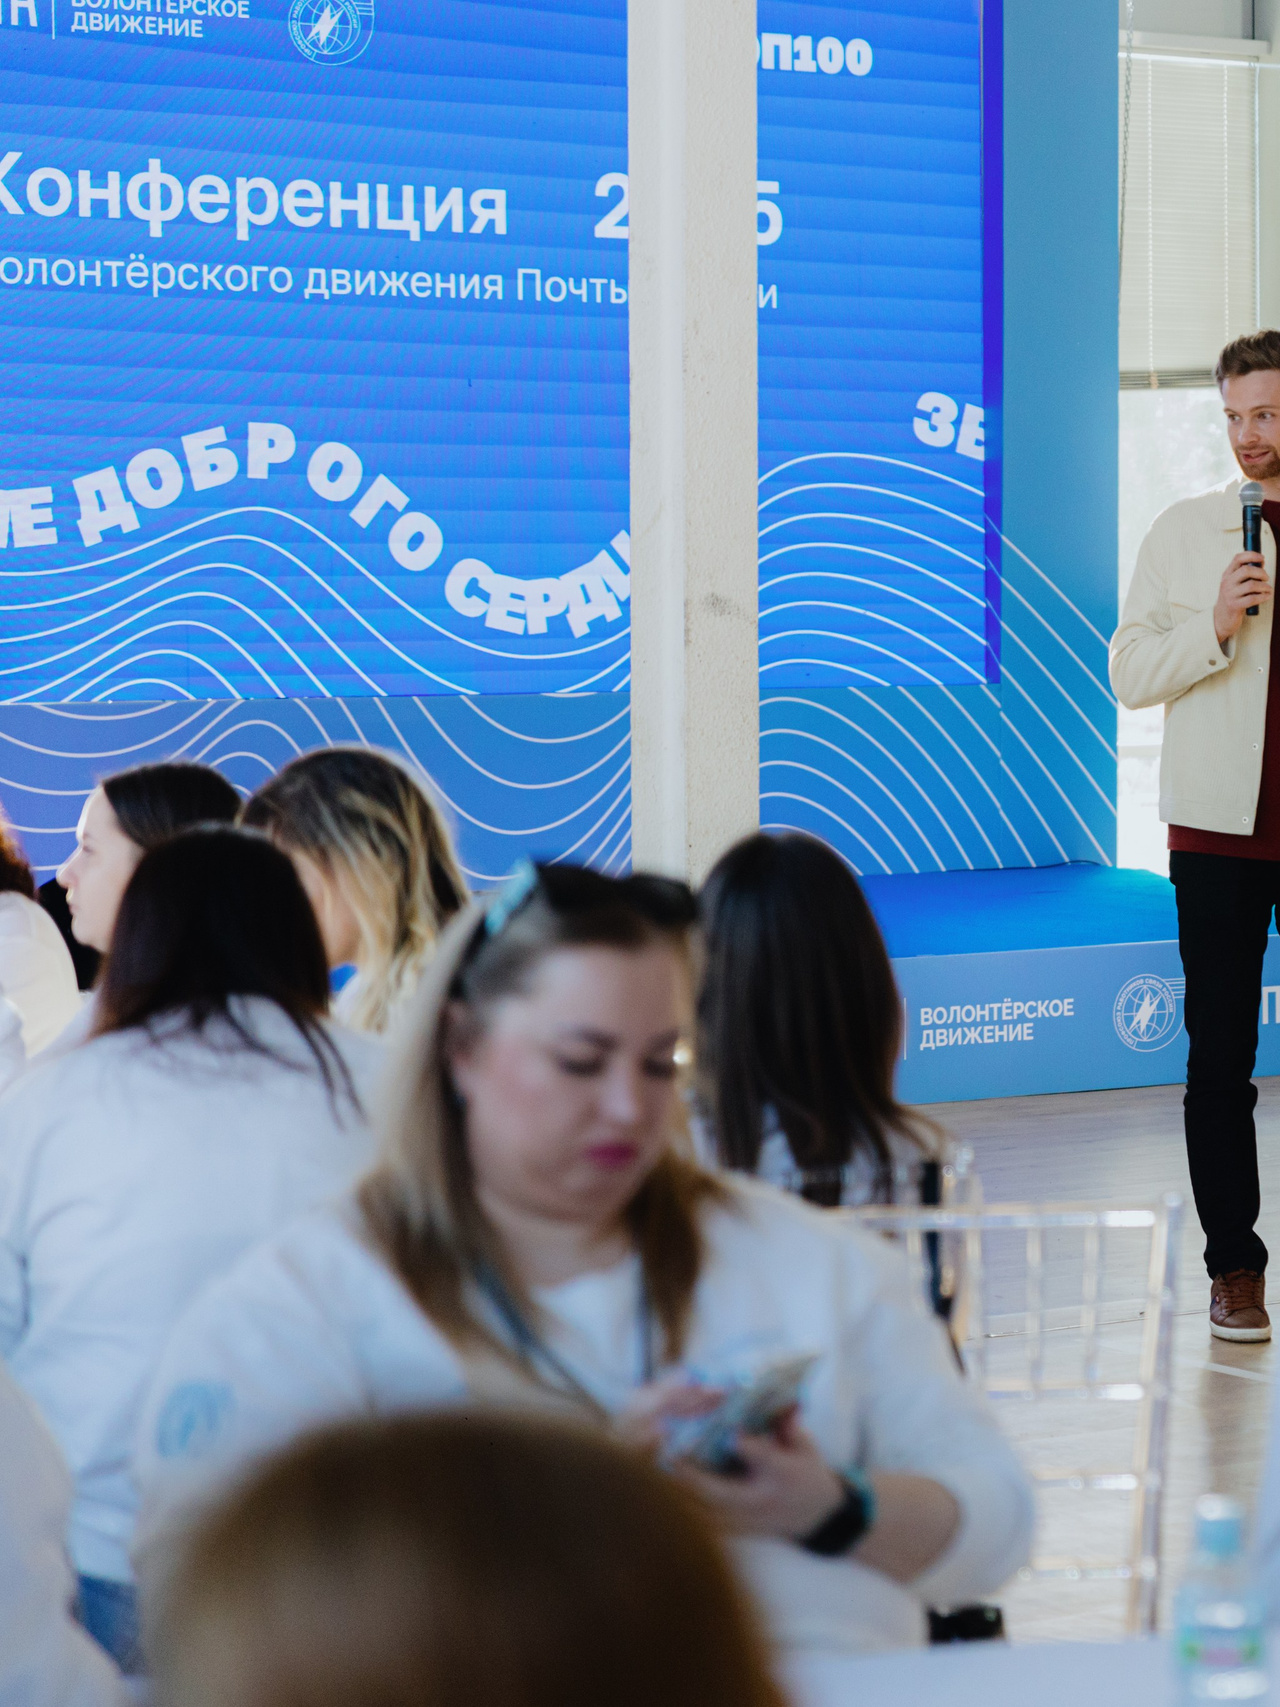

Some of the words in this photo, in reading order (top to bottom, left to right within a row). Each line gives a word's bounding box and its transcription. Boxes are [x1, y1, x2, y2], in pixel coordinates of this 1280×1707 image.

[71, 12, 204, 38] ДВИЖЕНИЕ
[756, 32, 873, 77] П100
[0, 253, 293, 298] олонтёрского
[304, 268, 503, 300] движения
[73, 422, 444, 571] ДОБРОГО
[920, 998, 1075, 1026] ВОЛОНТЁРСКОЕ
[919, 1022, 1034, 1051] ДВИЖЕНИЕ
